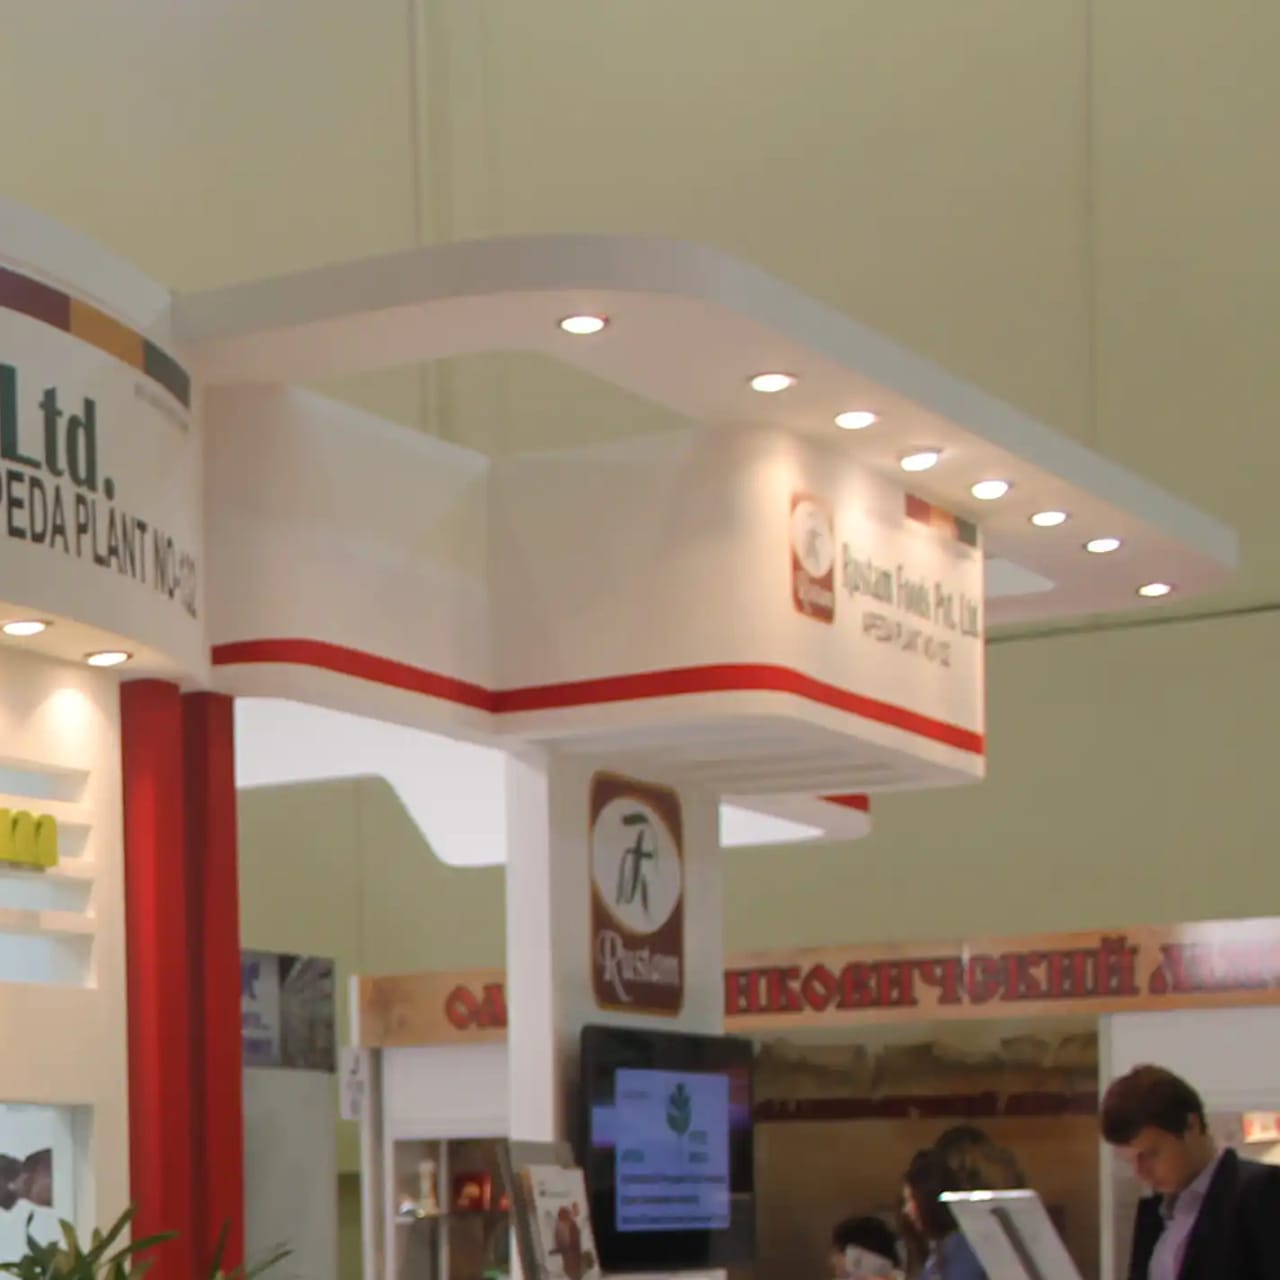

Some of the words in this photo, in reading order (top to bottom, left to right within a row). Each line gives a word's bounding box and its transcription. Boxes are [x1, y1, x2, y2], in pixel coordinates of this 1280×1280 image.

[74, 491, 148, 584] PLANT
[596, 928, 680, 1003] Rustam
[724, 935, 1140, 1016] НКОВИЧСКИЙ
